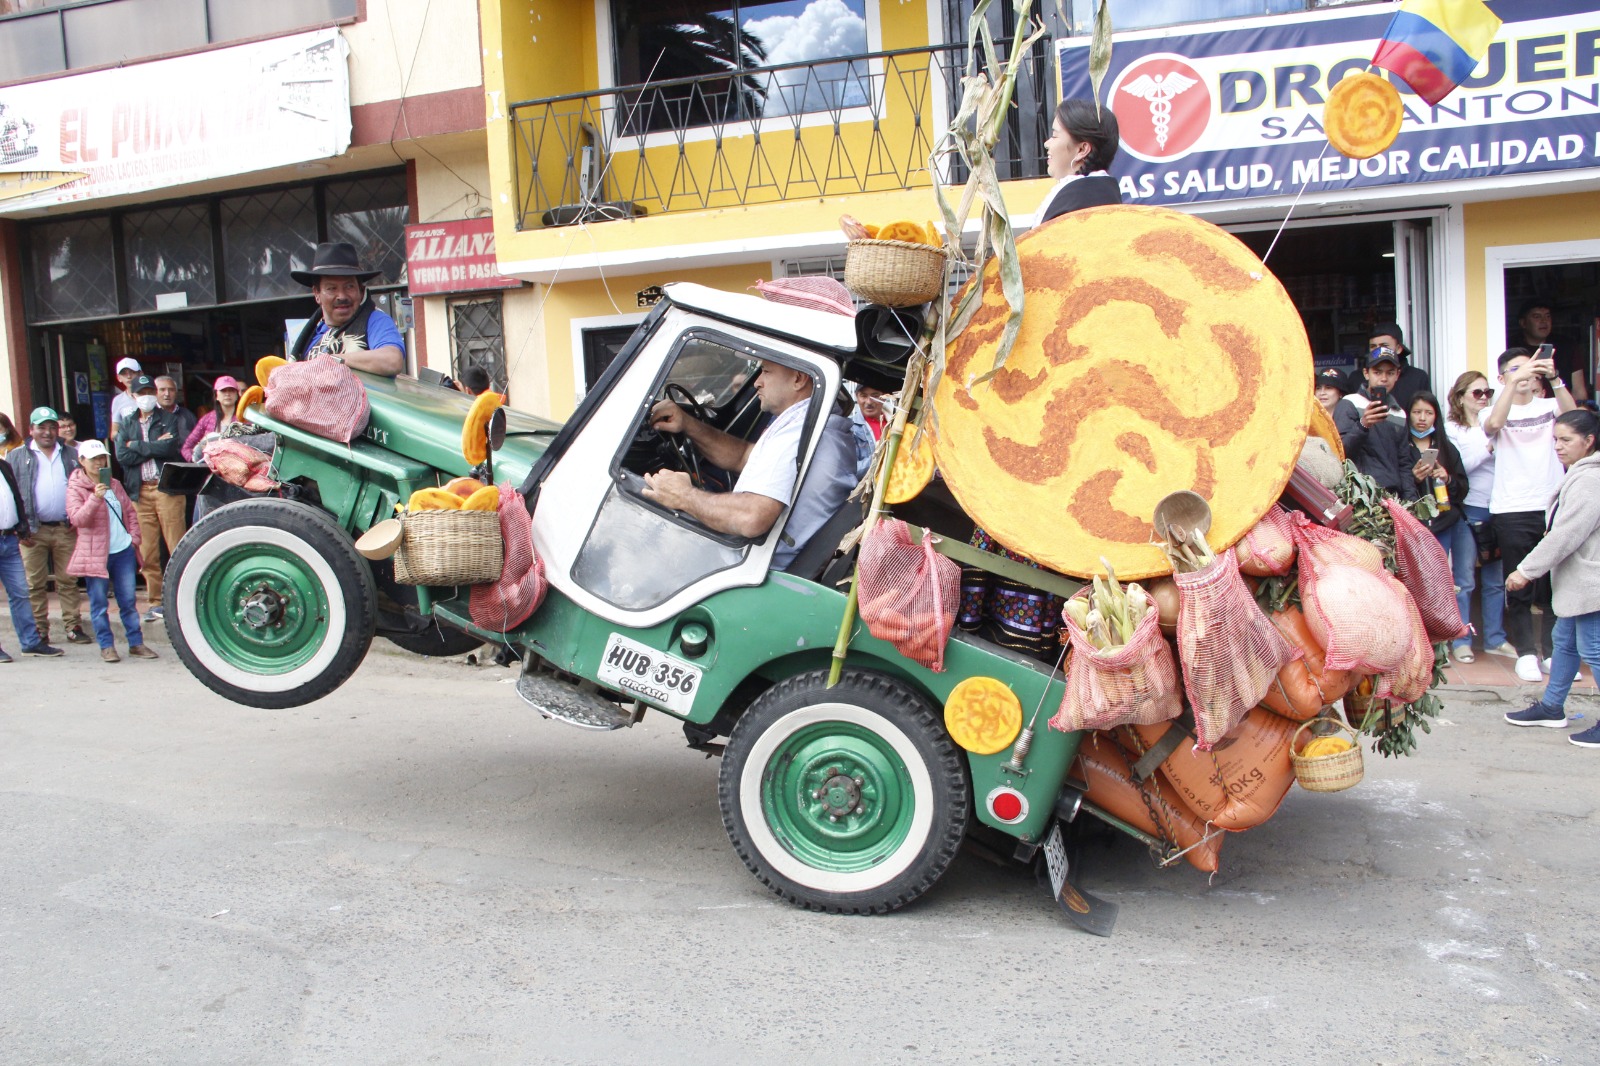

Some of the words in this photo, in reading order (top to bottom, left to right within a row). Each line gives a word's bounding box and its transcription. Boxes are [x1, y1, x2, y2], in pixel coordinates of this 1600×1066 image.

[60, 108, 98, 165] EL
[1118, 173, 1156, 199] AS
[1163, 163, 1283, 196] SALUD,
[1291, 149, 1411, 185] MEJOR
[1418, 133, 1585, 173] CALIDAD
[408, 232, 496, 262] ALIANZ
[409, 228, 446, 239] TRANS.
[413, 266, 450, 284] VENTA
[451, 265, 467, 281] DE
[469, 262, 502, 279] PASA
[607, 645, 651, 676] HUB
[654, 663, 695, 693] 356
[619, 677, 669, 703] CIRCASIA
[1228, 767, 1263, 796] 0Kg
